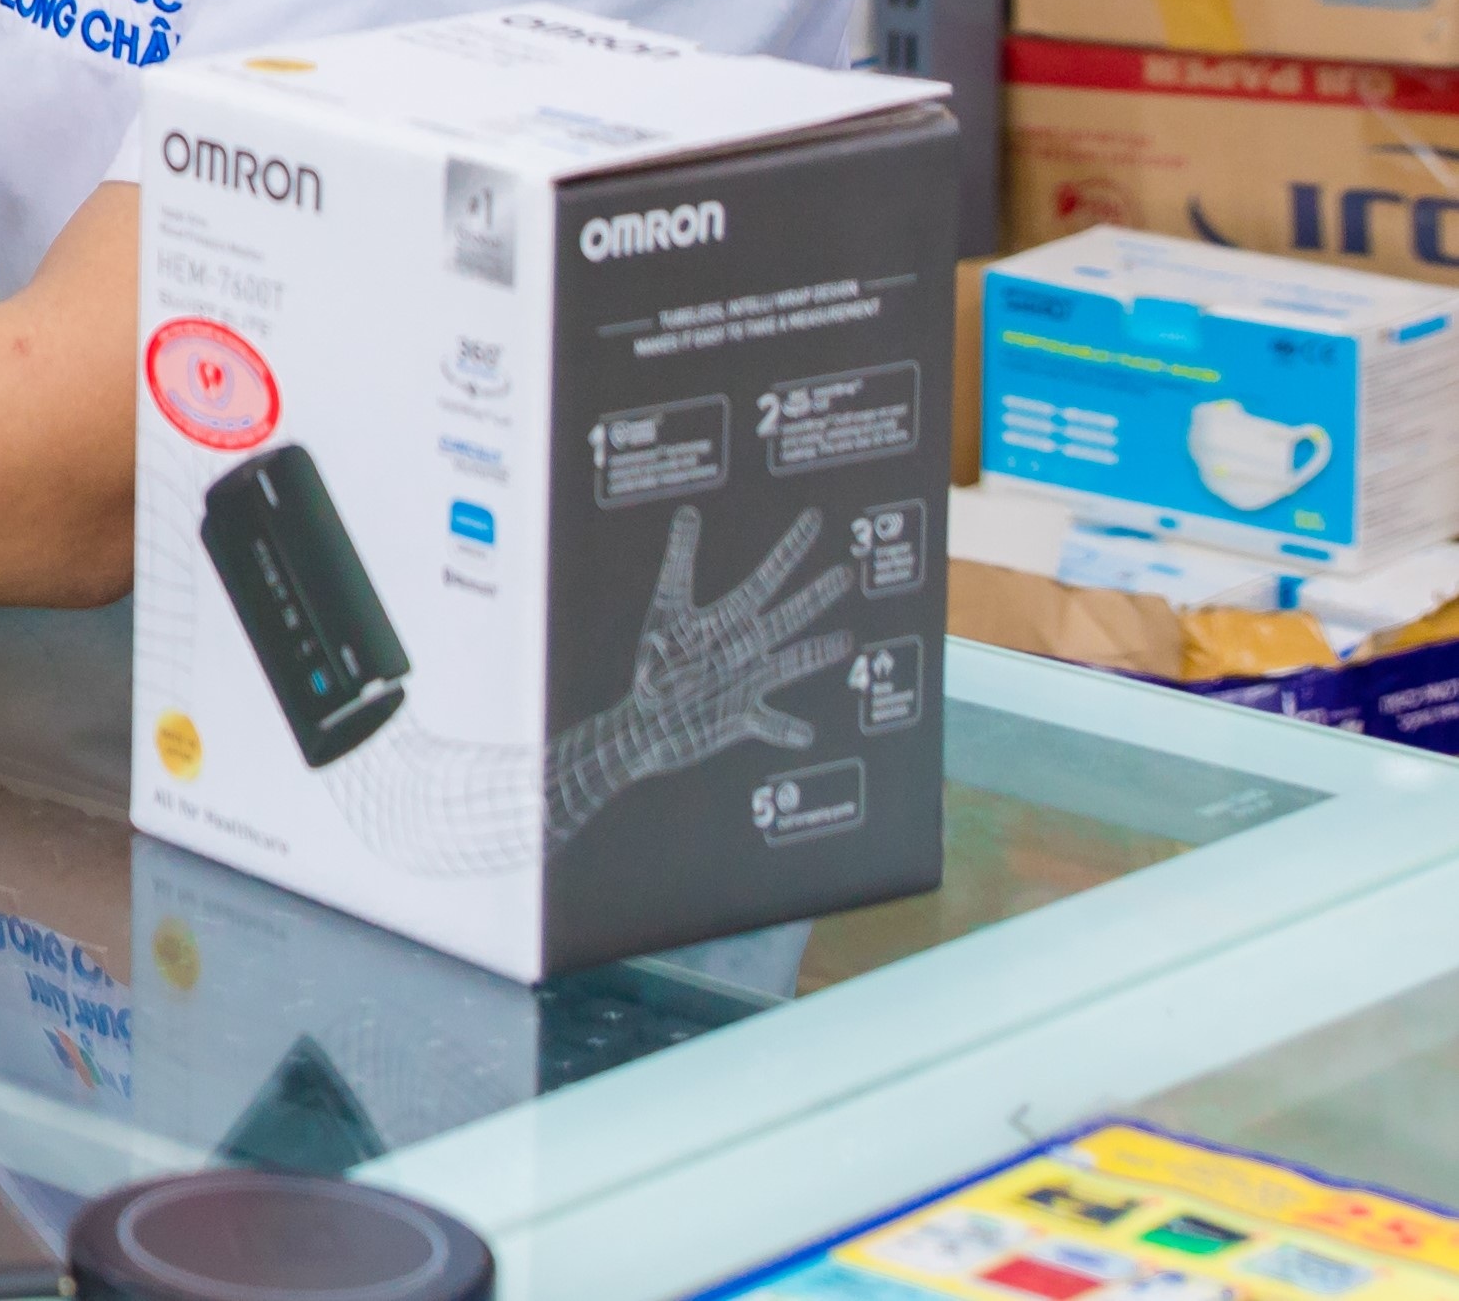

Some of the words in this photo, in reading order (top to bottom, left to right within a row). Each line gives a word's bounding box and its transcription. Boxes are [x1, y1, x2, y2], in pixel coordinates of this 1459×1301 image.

[80, 10, 182, 68] CHÂ
[161, 130, 323, 214] OMRON
[579, 199, 725, 263] OMRON
[754, 391, 781, 438] 2
[849, 516, 873, 559] 3
[847, 653, 871, 693] 4
[750, 784, 775, 830] 5
